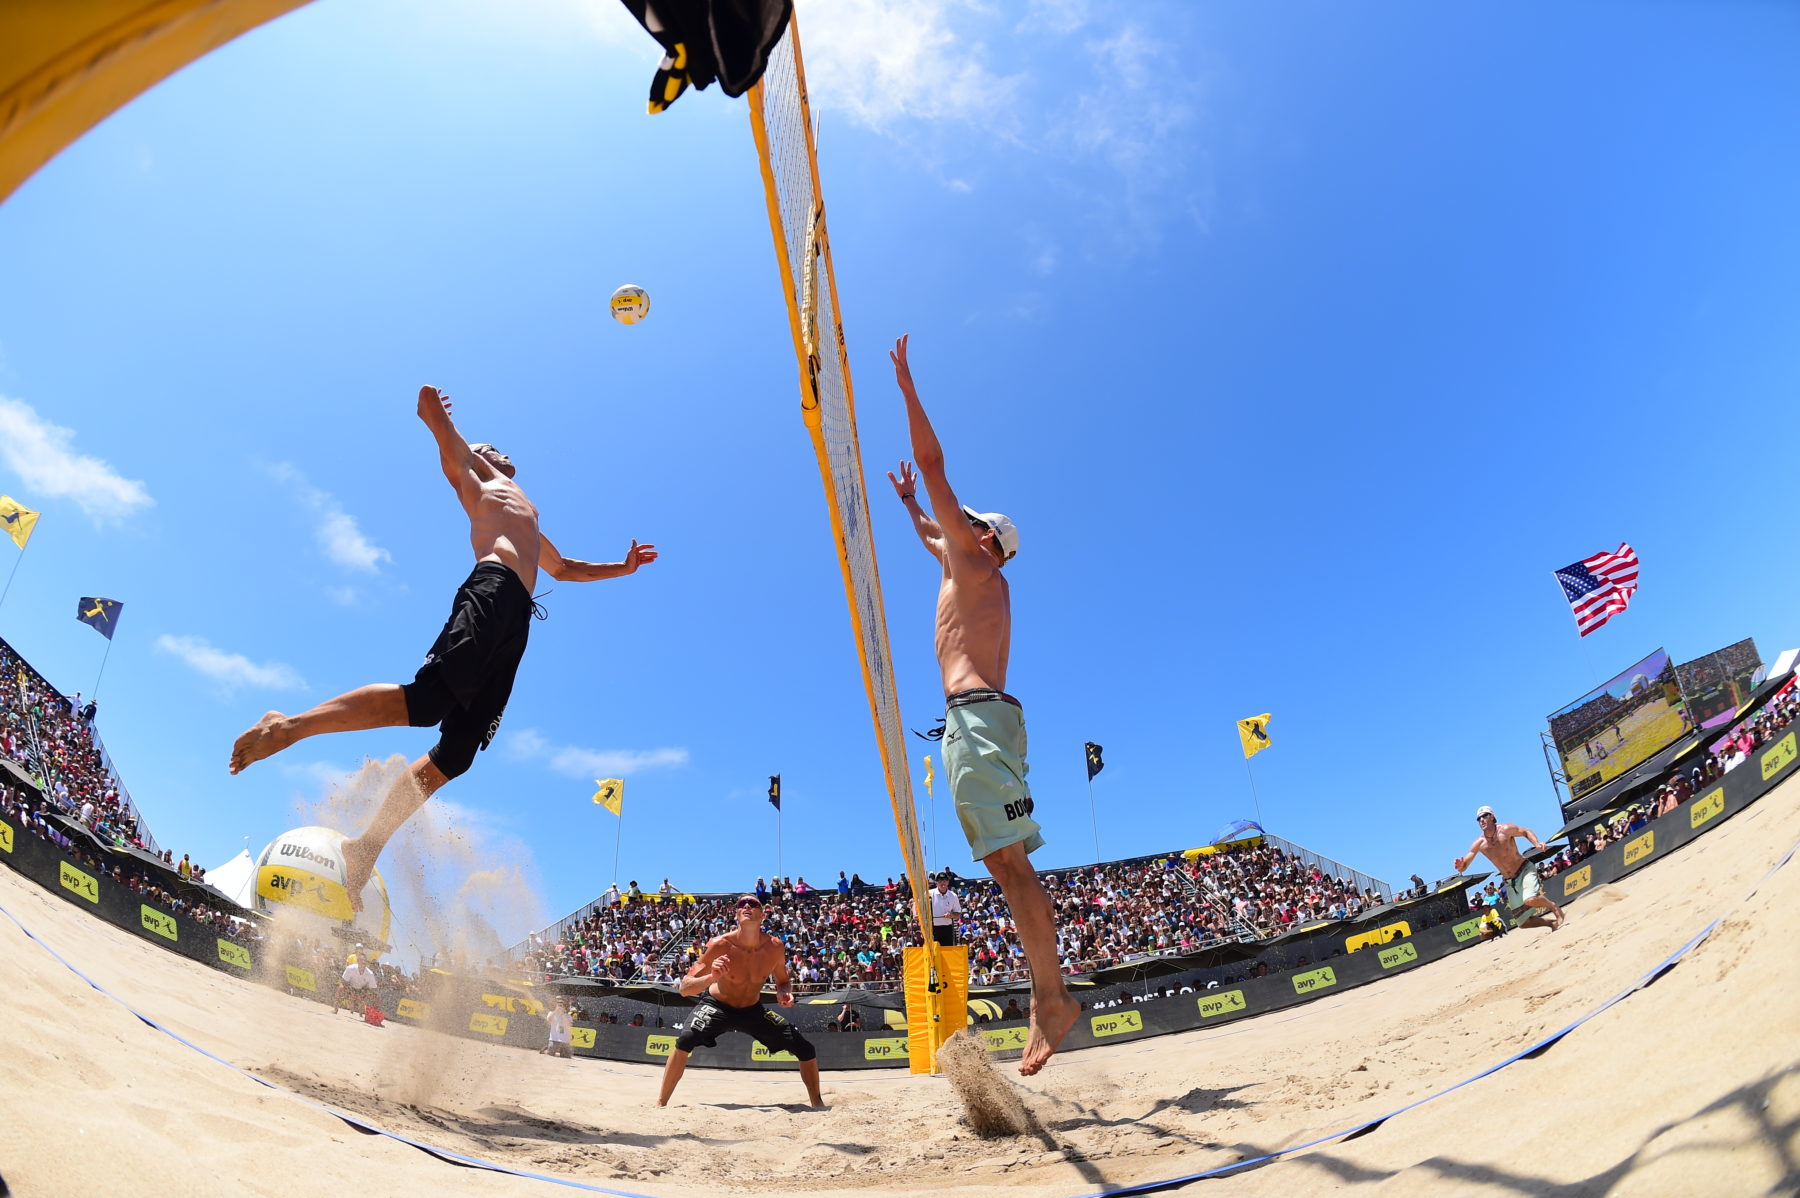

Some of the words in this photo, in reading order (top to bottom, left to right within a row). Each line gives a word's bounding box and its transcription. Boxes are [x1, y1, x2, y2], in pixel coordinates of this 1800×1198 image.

[1764, 756, 1780, 772] avp
[1693, 807, 1708, 821] avp
[280, 844, 335, 870] Wilson
[1626, 847, 1639, 859] avp
[63, 872, 79, 888] avp
[271, 874, 303, 896] avp
[1565, 879, 1578, 889] avp
[144, 914, 160, 929] avp
[1457, 928, 1471, 938] avp
[220, 947, 235, 960] avp
[1383, 954, 1399, 964] avp
[1297, 979, 1315, 989] avp
[1203, 1001, 1223, 1012] avp
[1096, 1021, 1118, 1032] avp
[649, 1042, 669, 1052] avp
[755, 1046, 772, 1057] av
[868, 1045, 890, 1056] avp
